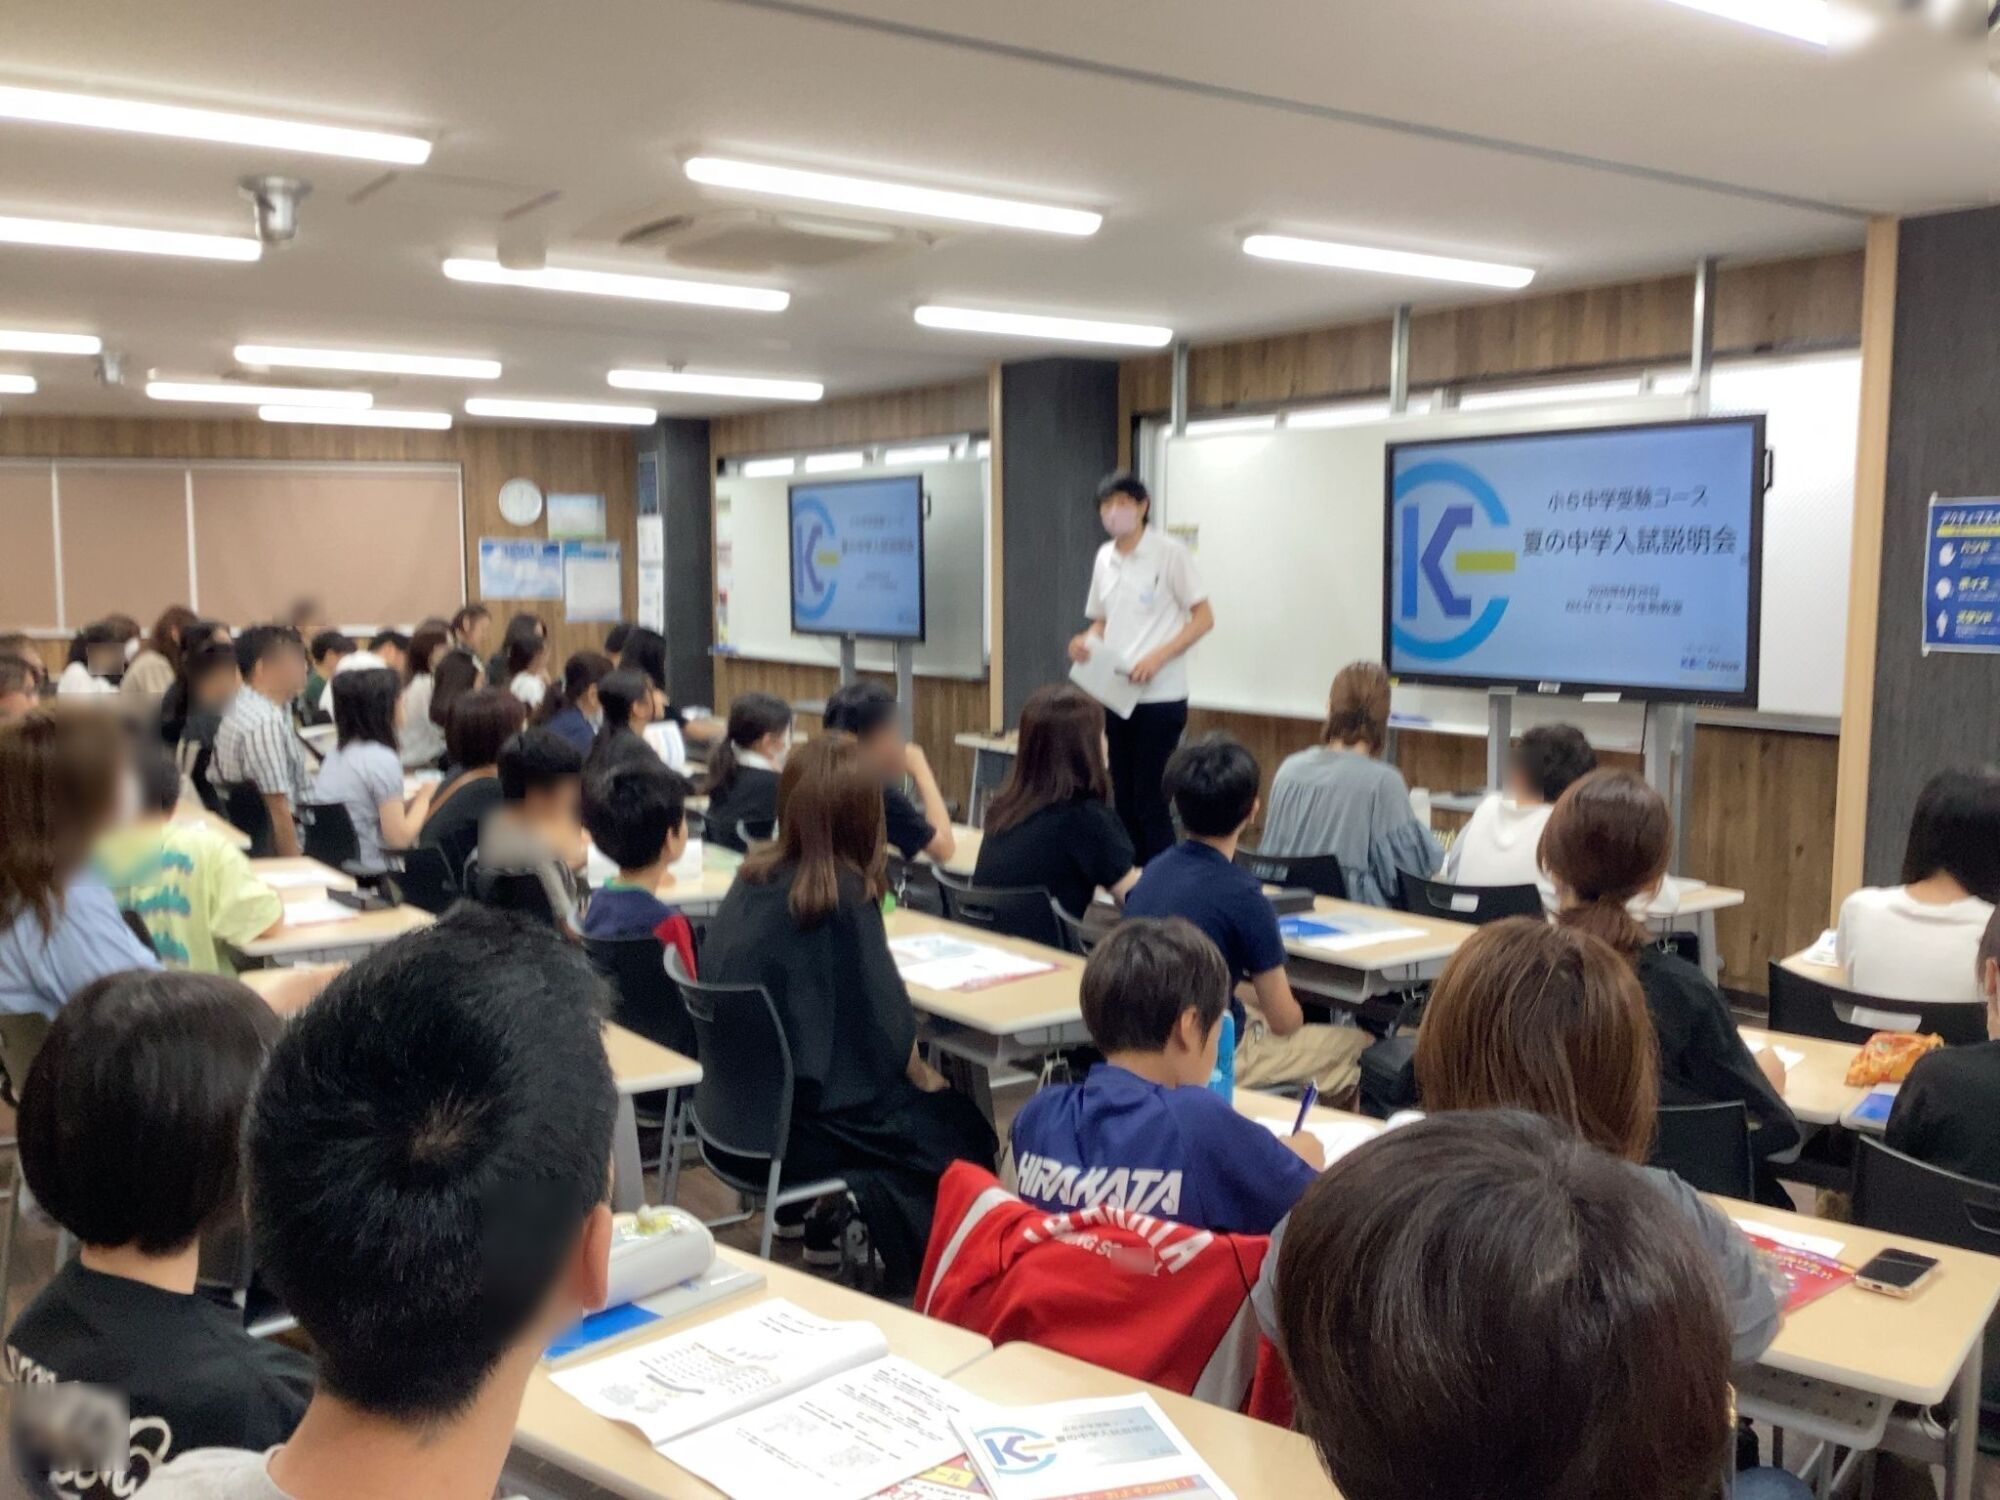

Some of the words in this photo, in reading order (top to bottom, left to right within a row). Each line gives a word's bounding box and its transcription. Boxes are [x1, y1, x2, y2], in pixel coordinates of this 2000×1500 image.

[1523, 522, 1737, 557] 夏の中学入試説明会
[1017, 1150, 1182, 1216] HIRAKATA
